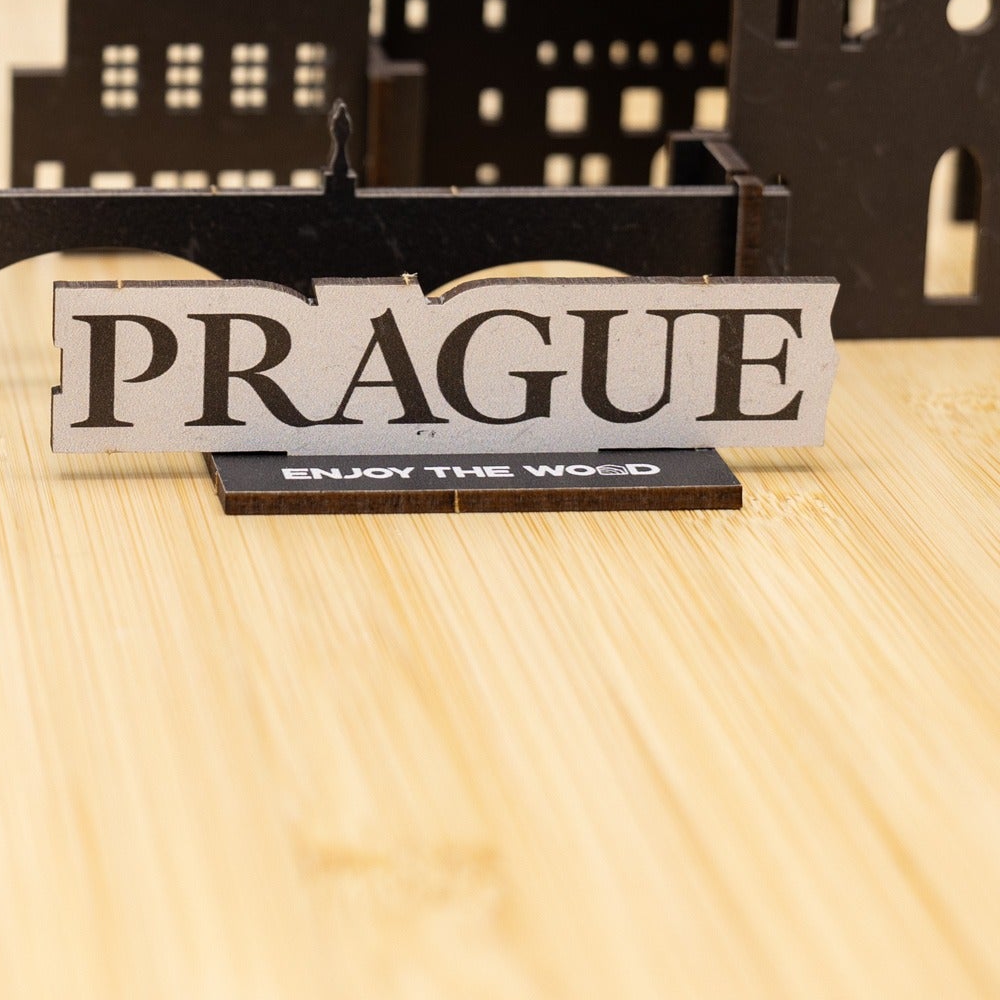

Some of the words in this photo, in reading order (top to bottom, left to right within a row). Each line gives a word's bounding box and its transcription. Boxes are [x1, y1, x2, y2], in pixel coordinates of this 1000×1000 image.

[71, 307, 804, 428] PRAGUE
[281, 466, 415, 480] ENJOY
[424, 465, 514, 479] THE
[523, 463, 661, 477] WOOD
